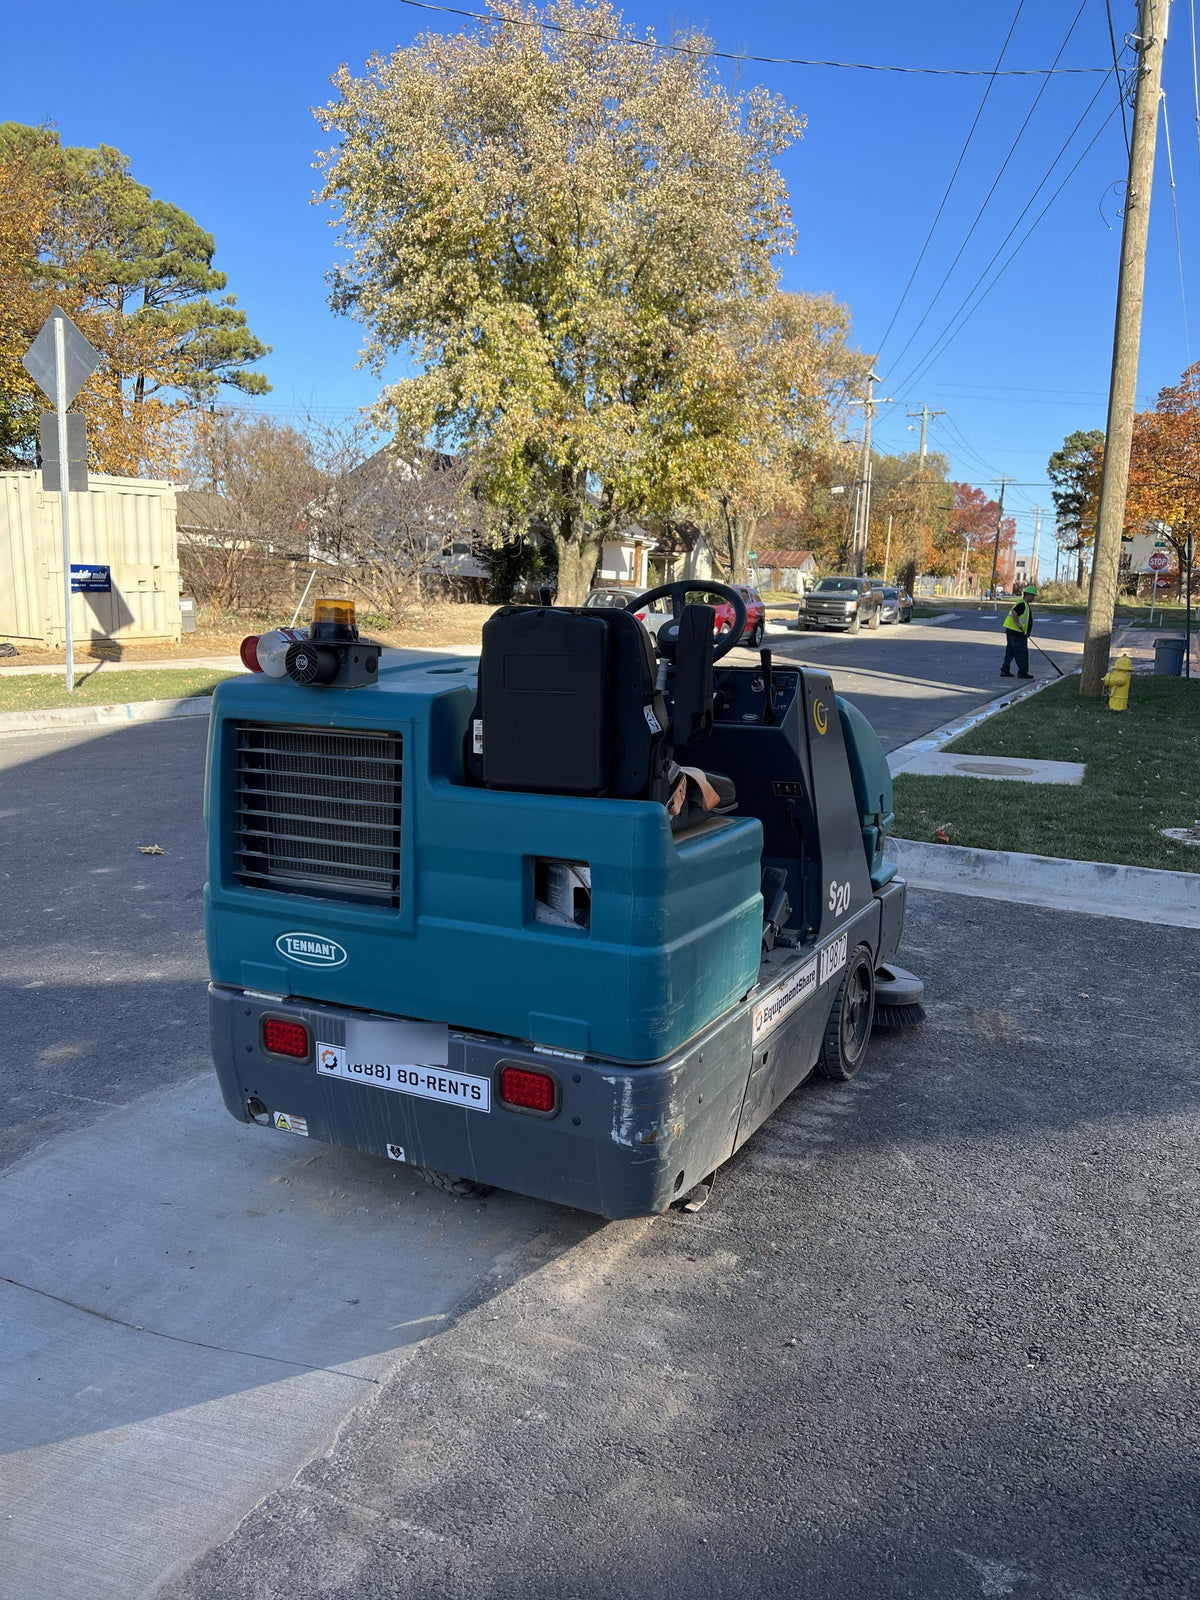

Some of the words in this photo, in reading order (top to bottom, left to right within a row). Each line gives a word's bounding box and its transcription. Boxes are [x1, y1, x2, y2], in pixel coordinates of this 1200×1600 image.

[1150, 557, 1166, 566] STOP
[828, 880, 851, 918] S20
[285, 937, 337, 961] TENNANT
[763, 970, 816, 1024] EquipmentShare
[397, 1069, 482, 1101] 80-RENTS
